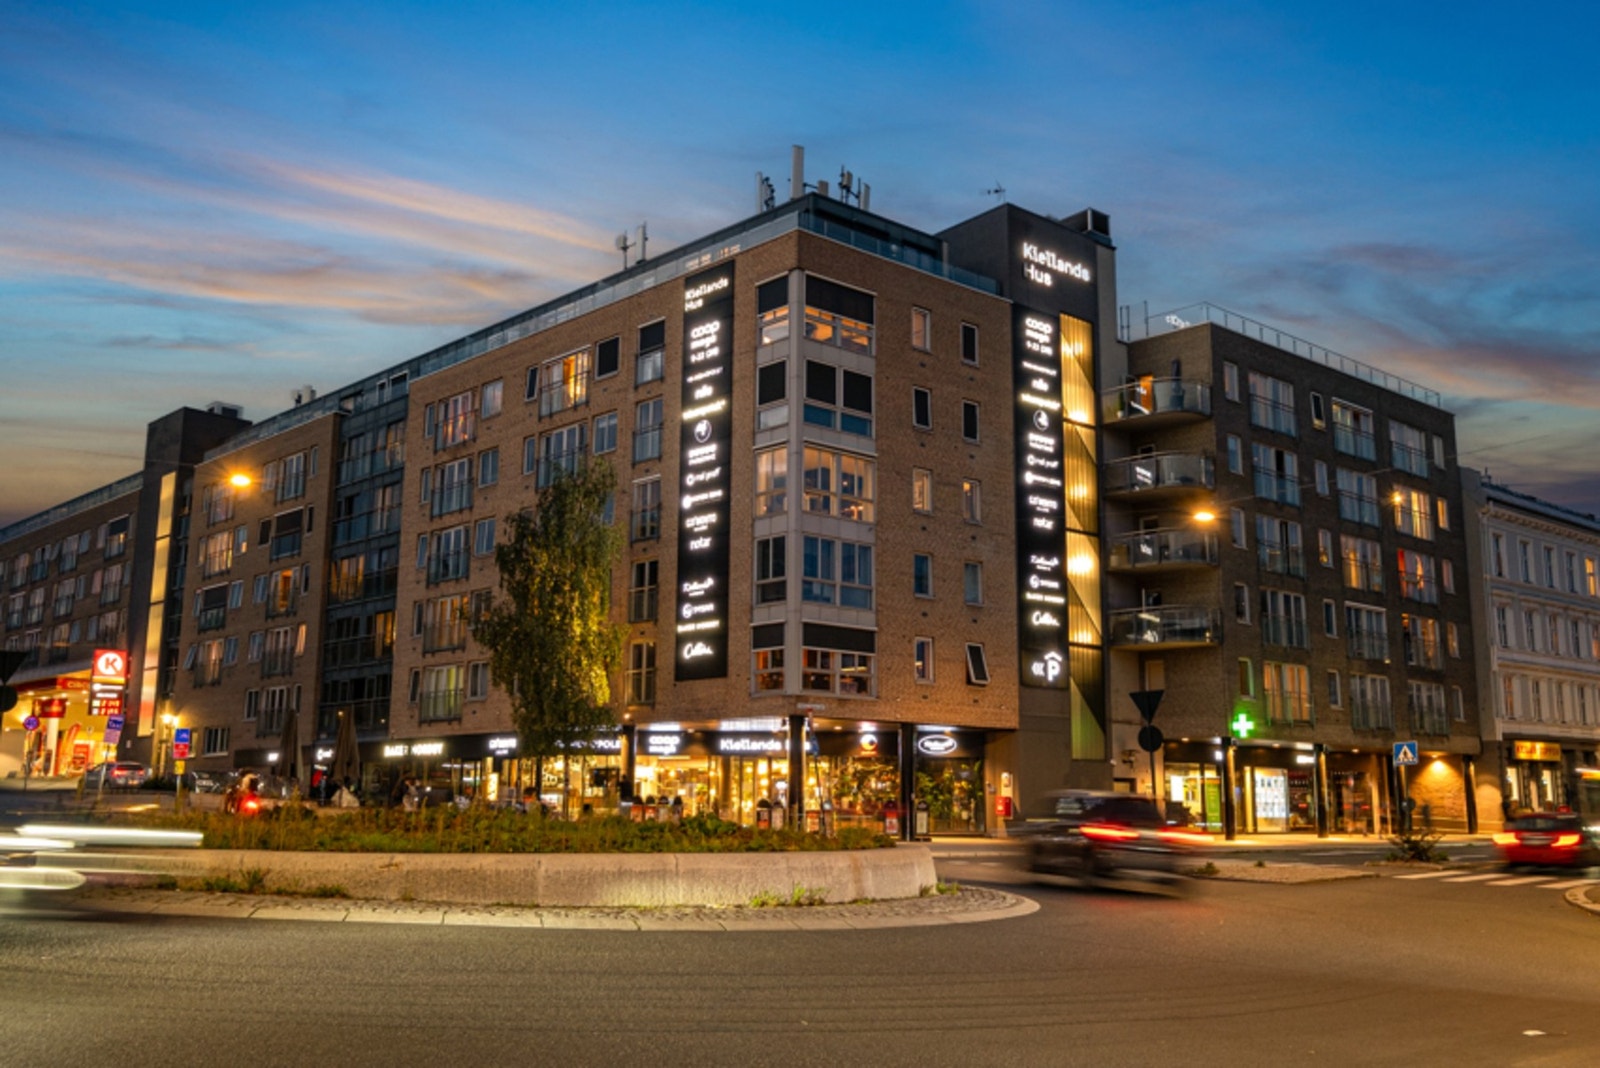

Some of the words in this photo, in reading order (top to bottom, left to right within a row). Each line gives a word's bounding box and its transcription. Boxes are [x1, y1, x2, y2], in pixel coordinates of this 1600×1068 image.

[1023, 242, 1090, 282] Kiellands
[1023, 262, 1052, 287] Hus
[105, 657, 120, 673] K
